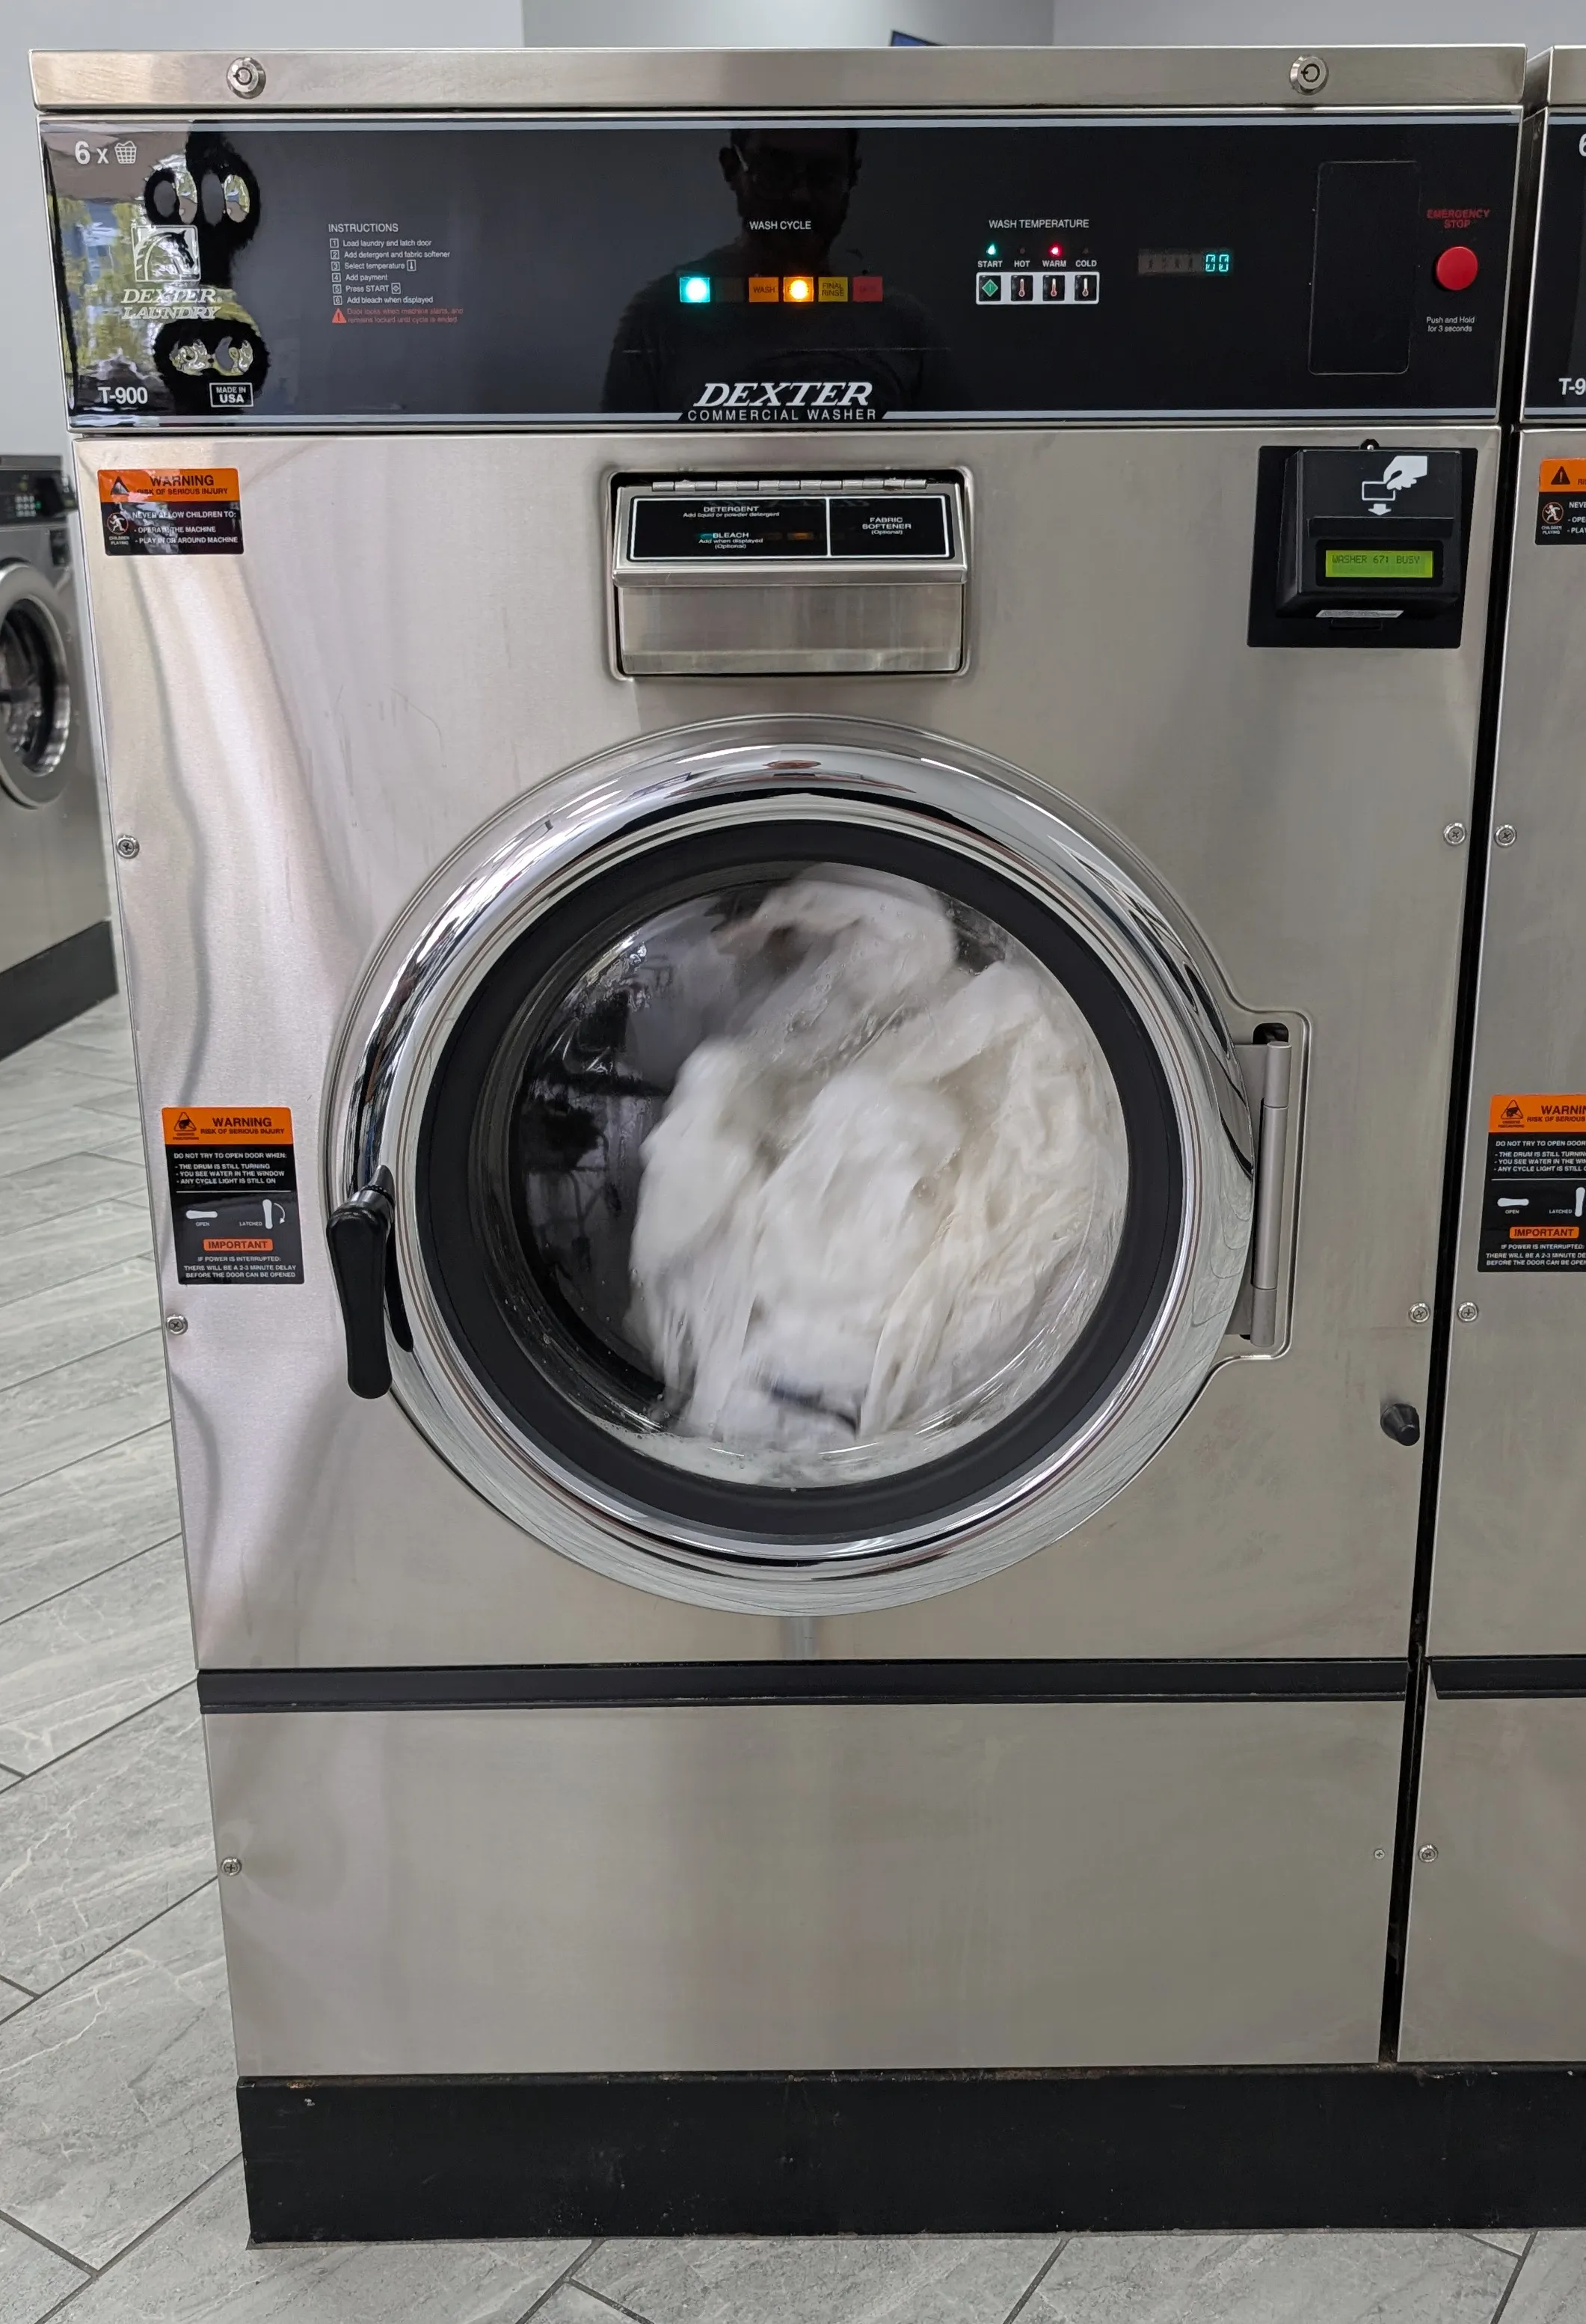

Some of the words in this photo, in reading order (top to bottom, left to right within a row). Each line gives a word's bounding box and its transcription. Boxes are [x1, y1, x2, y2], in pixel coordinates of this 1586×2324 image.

[75, 141, 90, 165] 6
[97, 150, 109, 164] x
[1427, 209, 1490, 218] EMERGENCY
[749, 221, 778, 230] WASH
[780, 221, 811, 230] CYCLE
[989, 220, 1016, 228] WASH
[1018, 220, 1089, 228] TEMPERATURE
[1444, 219, 1471, 228] STOP
[328, 224, 399, 233] INSTRUCTIONS
[360, 239, 384, 248] laundry
[359, 251, 389, 260] detergent
[121, 289, 217, 303] DEXTER
[403, 296, 434, 304] displayed
[121, 307, 221, 319] LAUNDRY
[98, 387, 148, 404] T-900
[219, 394, 245, 403] USA
[693, 382, 873, 406] DEXTER
[688, 410, 799, 420] COMMERCIAL
[808, 409, 876, 420] WASHER
[150, 476, 214, 486] WARNING
[1332, 555, 1367, 563] WASHER
[1396, 555, 1420, 563] BUSY
[212, 1117, 271, 1126] WARNING
